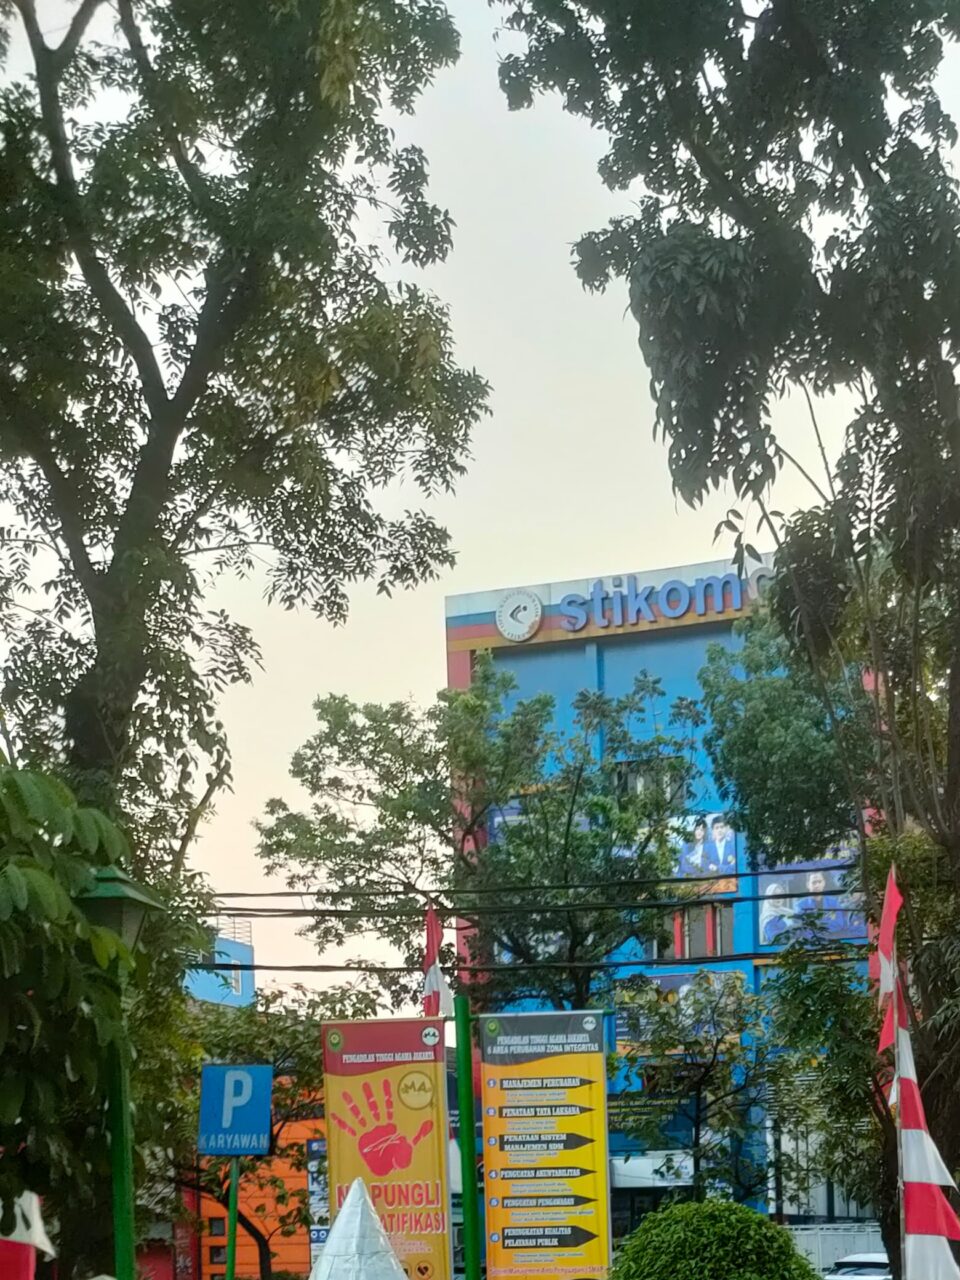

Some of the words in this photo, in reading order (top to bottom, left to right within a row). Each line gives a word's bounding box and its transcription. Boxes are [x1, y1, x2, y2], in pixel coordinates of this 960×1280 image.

[559, 572, 743, 632] stikom
[493, 1045, 509, 1055] AREA
[546, 1043, 563, 1053] ZONA
[563, 1042, 599, 1052] INTEGRITAS
[222, 1069, 253, 1129] P
[536, 1106, 552, 1117] TATA
[198, 1133, 269, 1150] KARYAWAN
[369, 1181, 441, 1209] PUNGLI
[381, 1212, 447, 1235] ATIFIKASI
